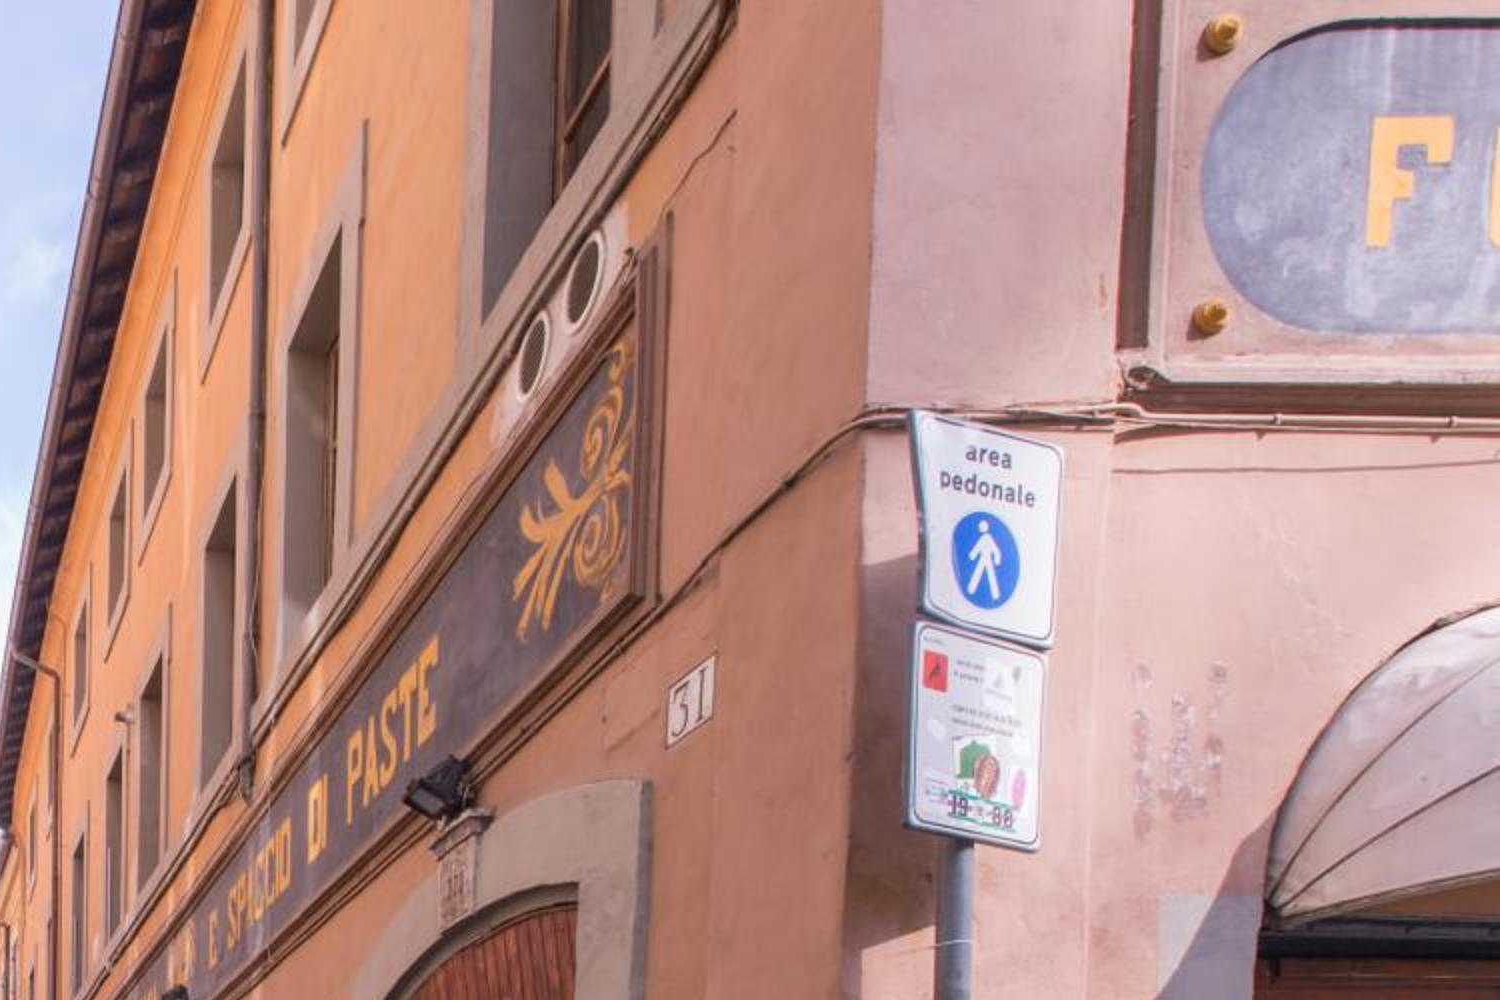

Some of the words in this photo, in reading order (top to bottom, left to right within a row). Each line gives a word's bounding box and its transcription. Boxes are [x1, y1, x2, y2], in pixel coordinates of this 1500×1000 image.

[965, 445, 1012, 470] area
[940, 470, 1036, 508] pedonale
[307, 773, 328, 866] DI
[346, 634, 441, 828] PASTE
